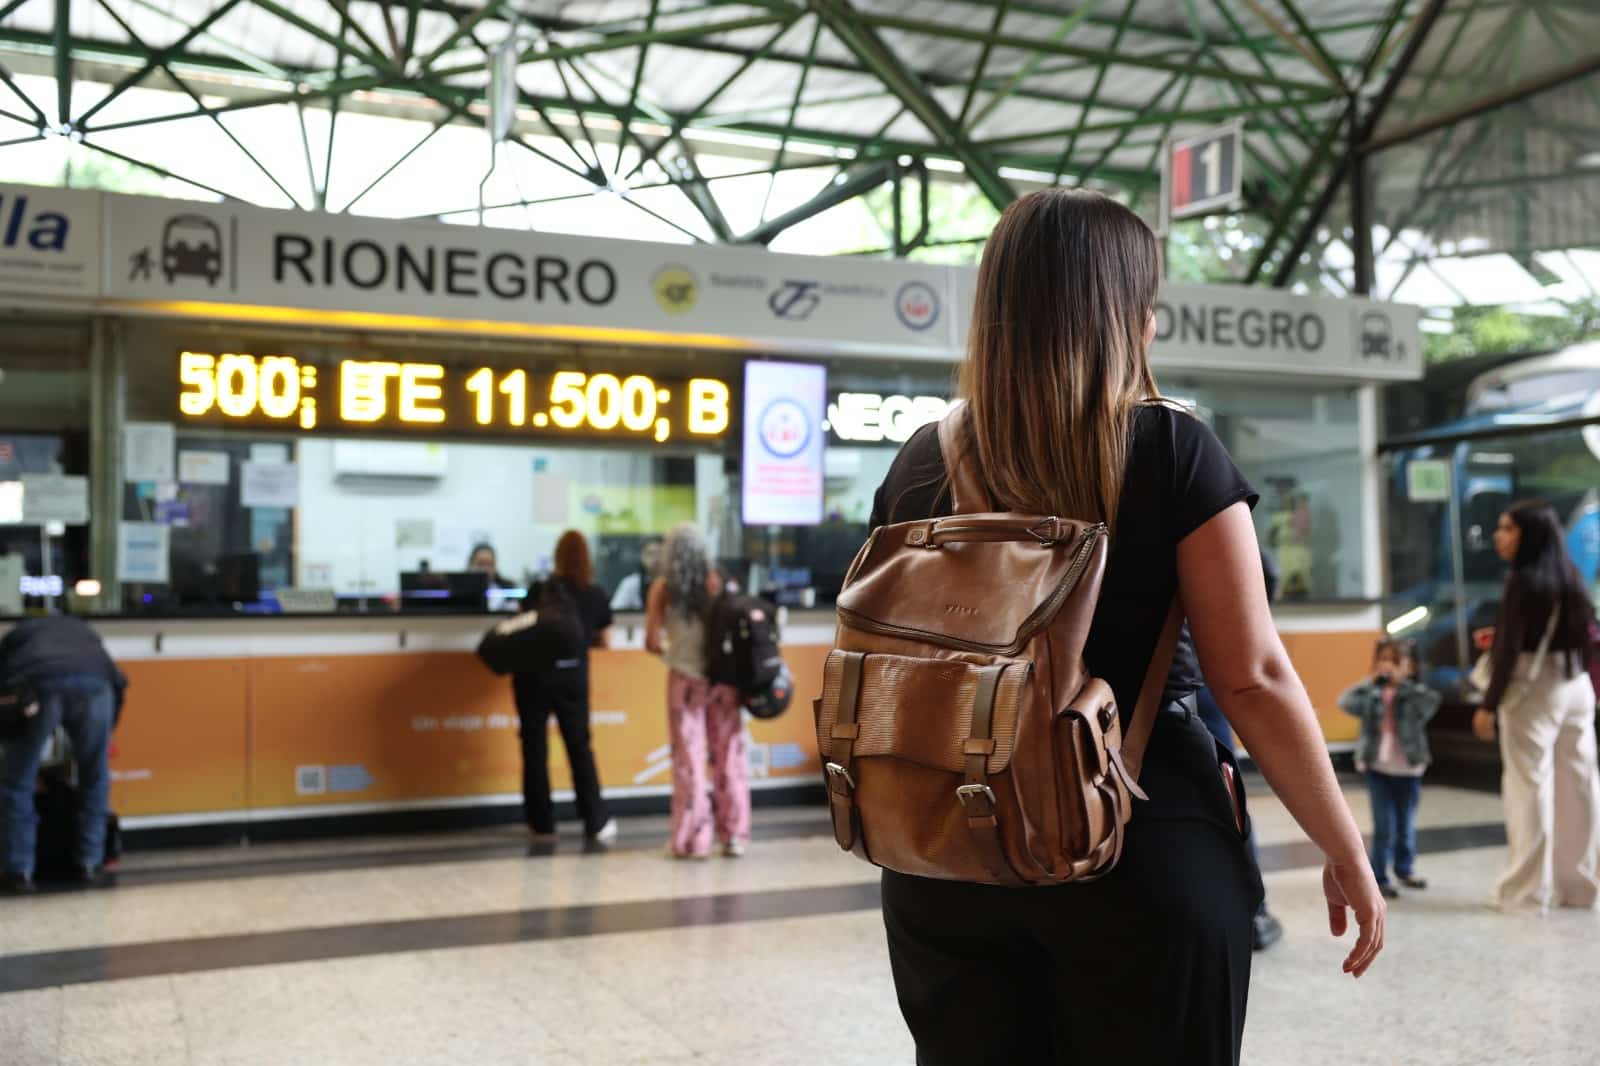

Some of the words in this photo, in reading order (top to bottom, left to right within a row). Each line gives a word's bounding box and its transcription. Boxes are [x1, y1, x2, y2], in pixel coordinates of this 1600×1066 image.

[1200, 141, 1222, 197] 1
[273, 232, 617, 307] RIONEGRO
[465, 366, 671, 442] 11.500;
[688, 377, 729, 434] B
